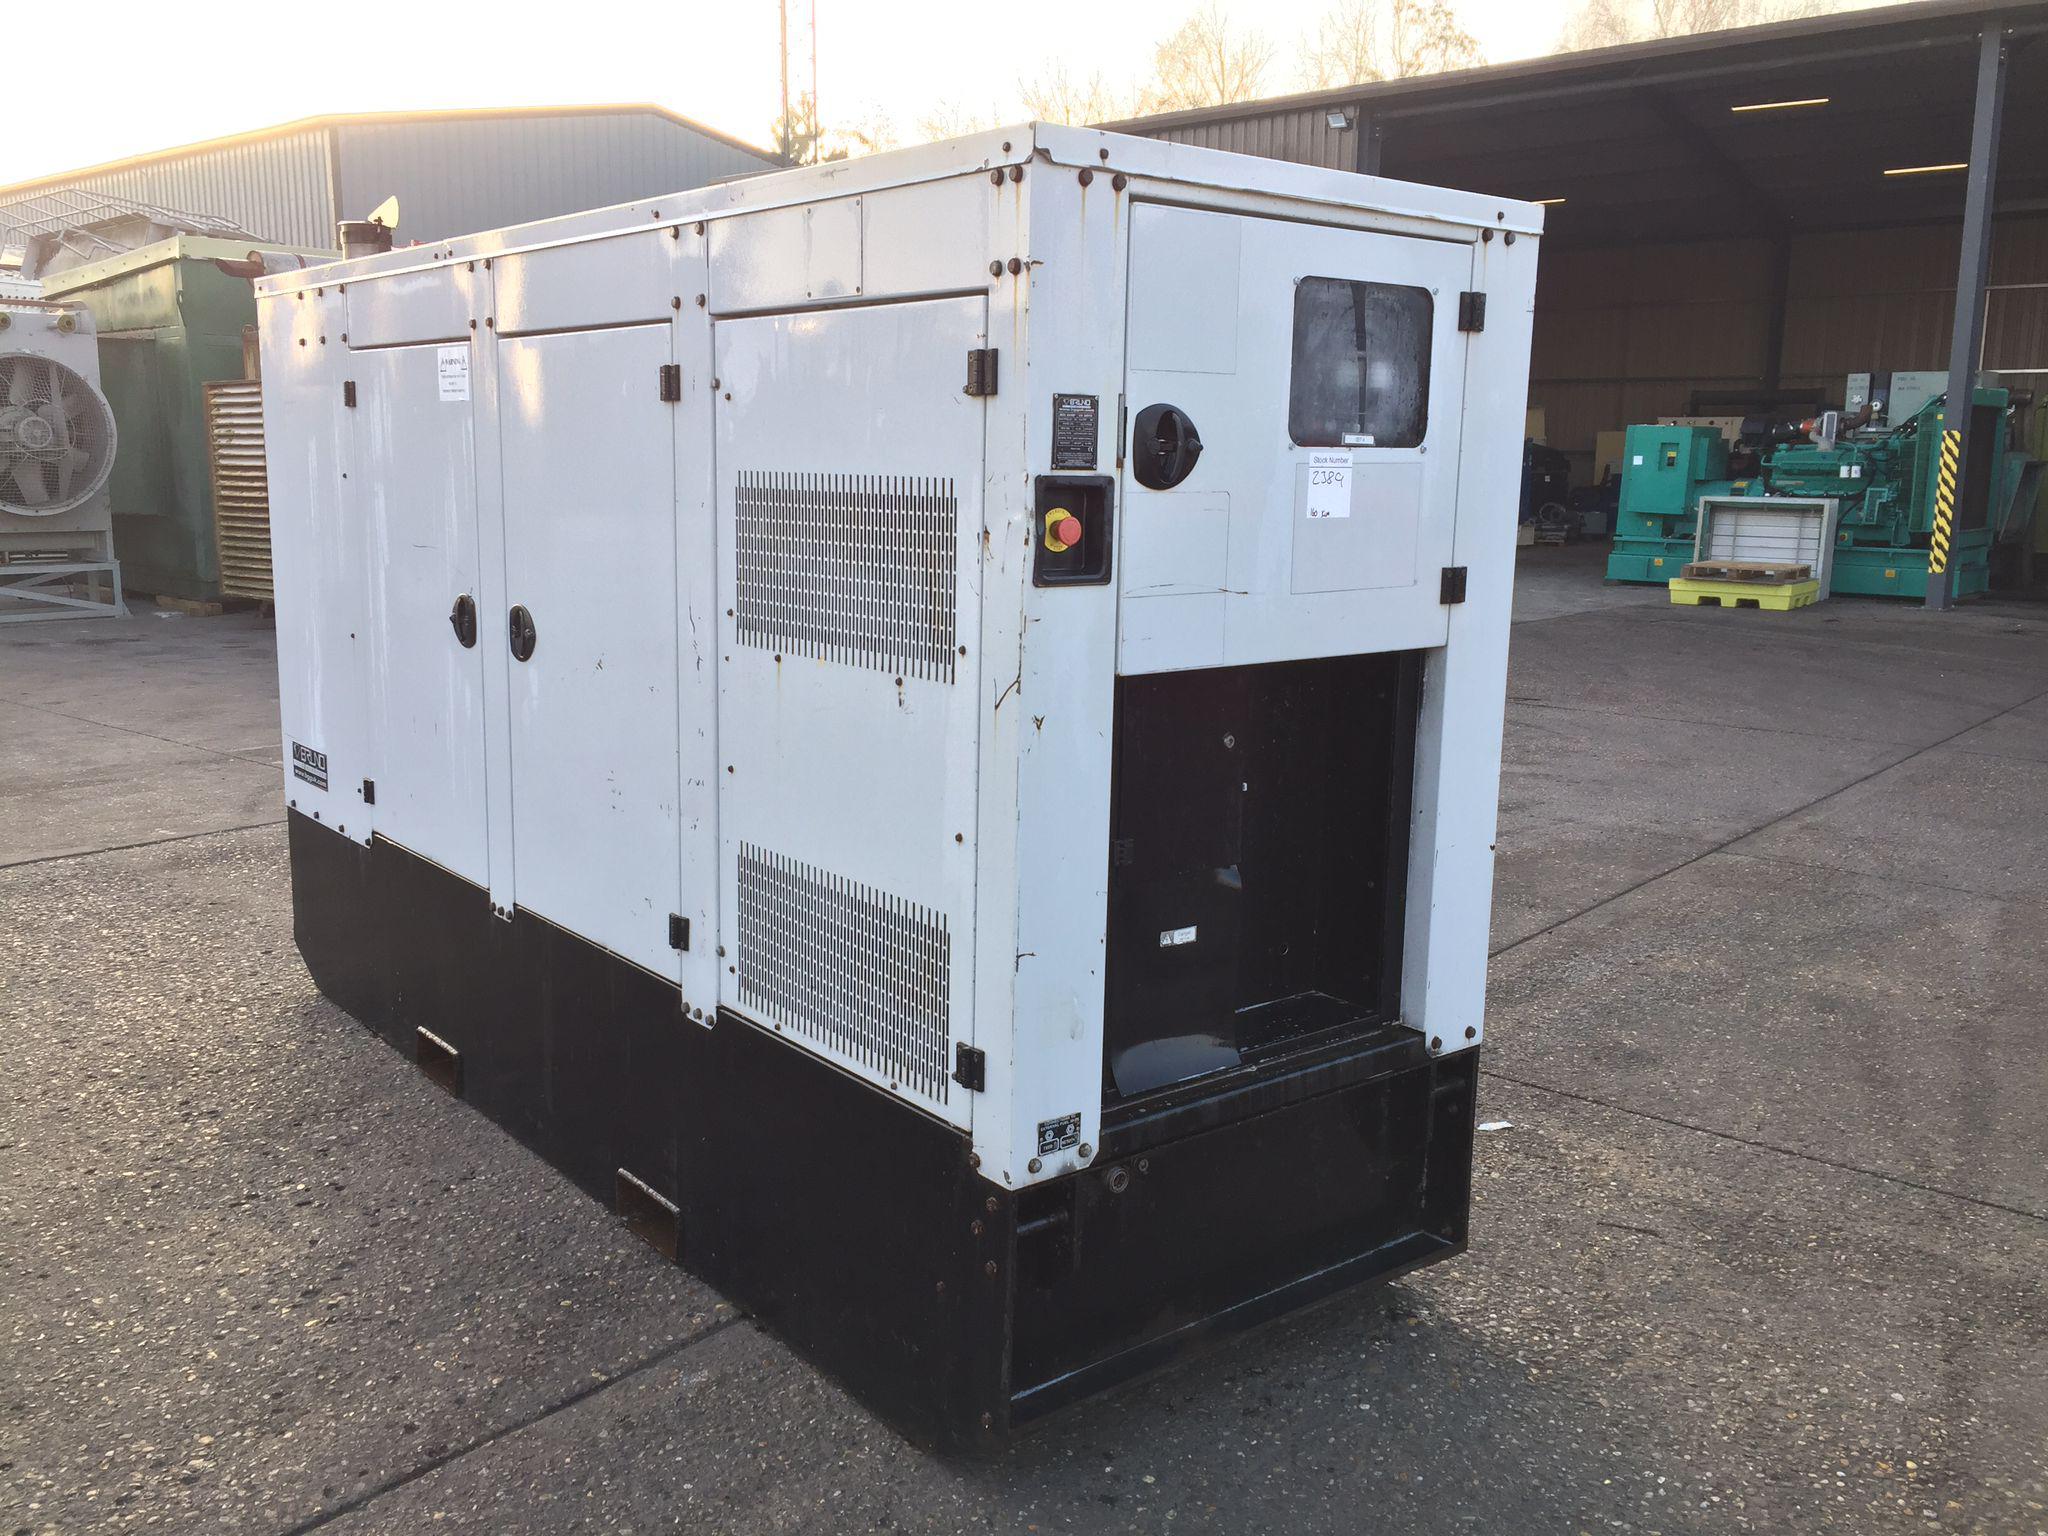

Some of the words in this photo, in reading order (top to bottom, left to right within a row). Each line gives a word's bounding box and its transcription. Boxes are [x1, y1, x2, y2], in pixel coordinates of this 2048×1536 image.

[1313, 456, 1328, 464] Stock
[1329, 456, 1350, 464] Number
[1312, 470, 1344, 488] 2389
[300, 746, 326, 771] BRUNO
